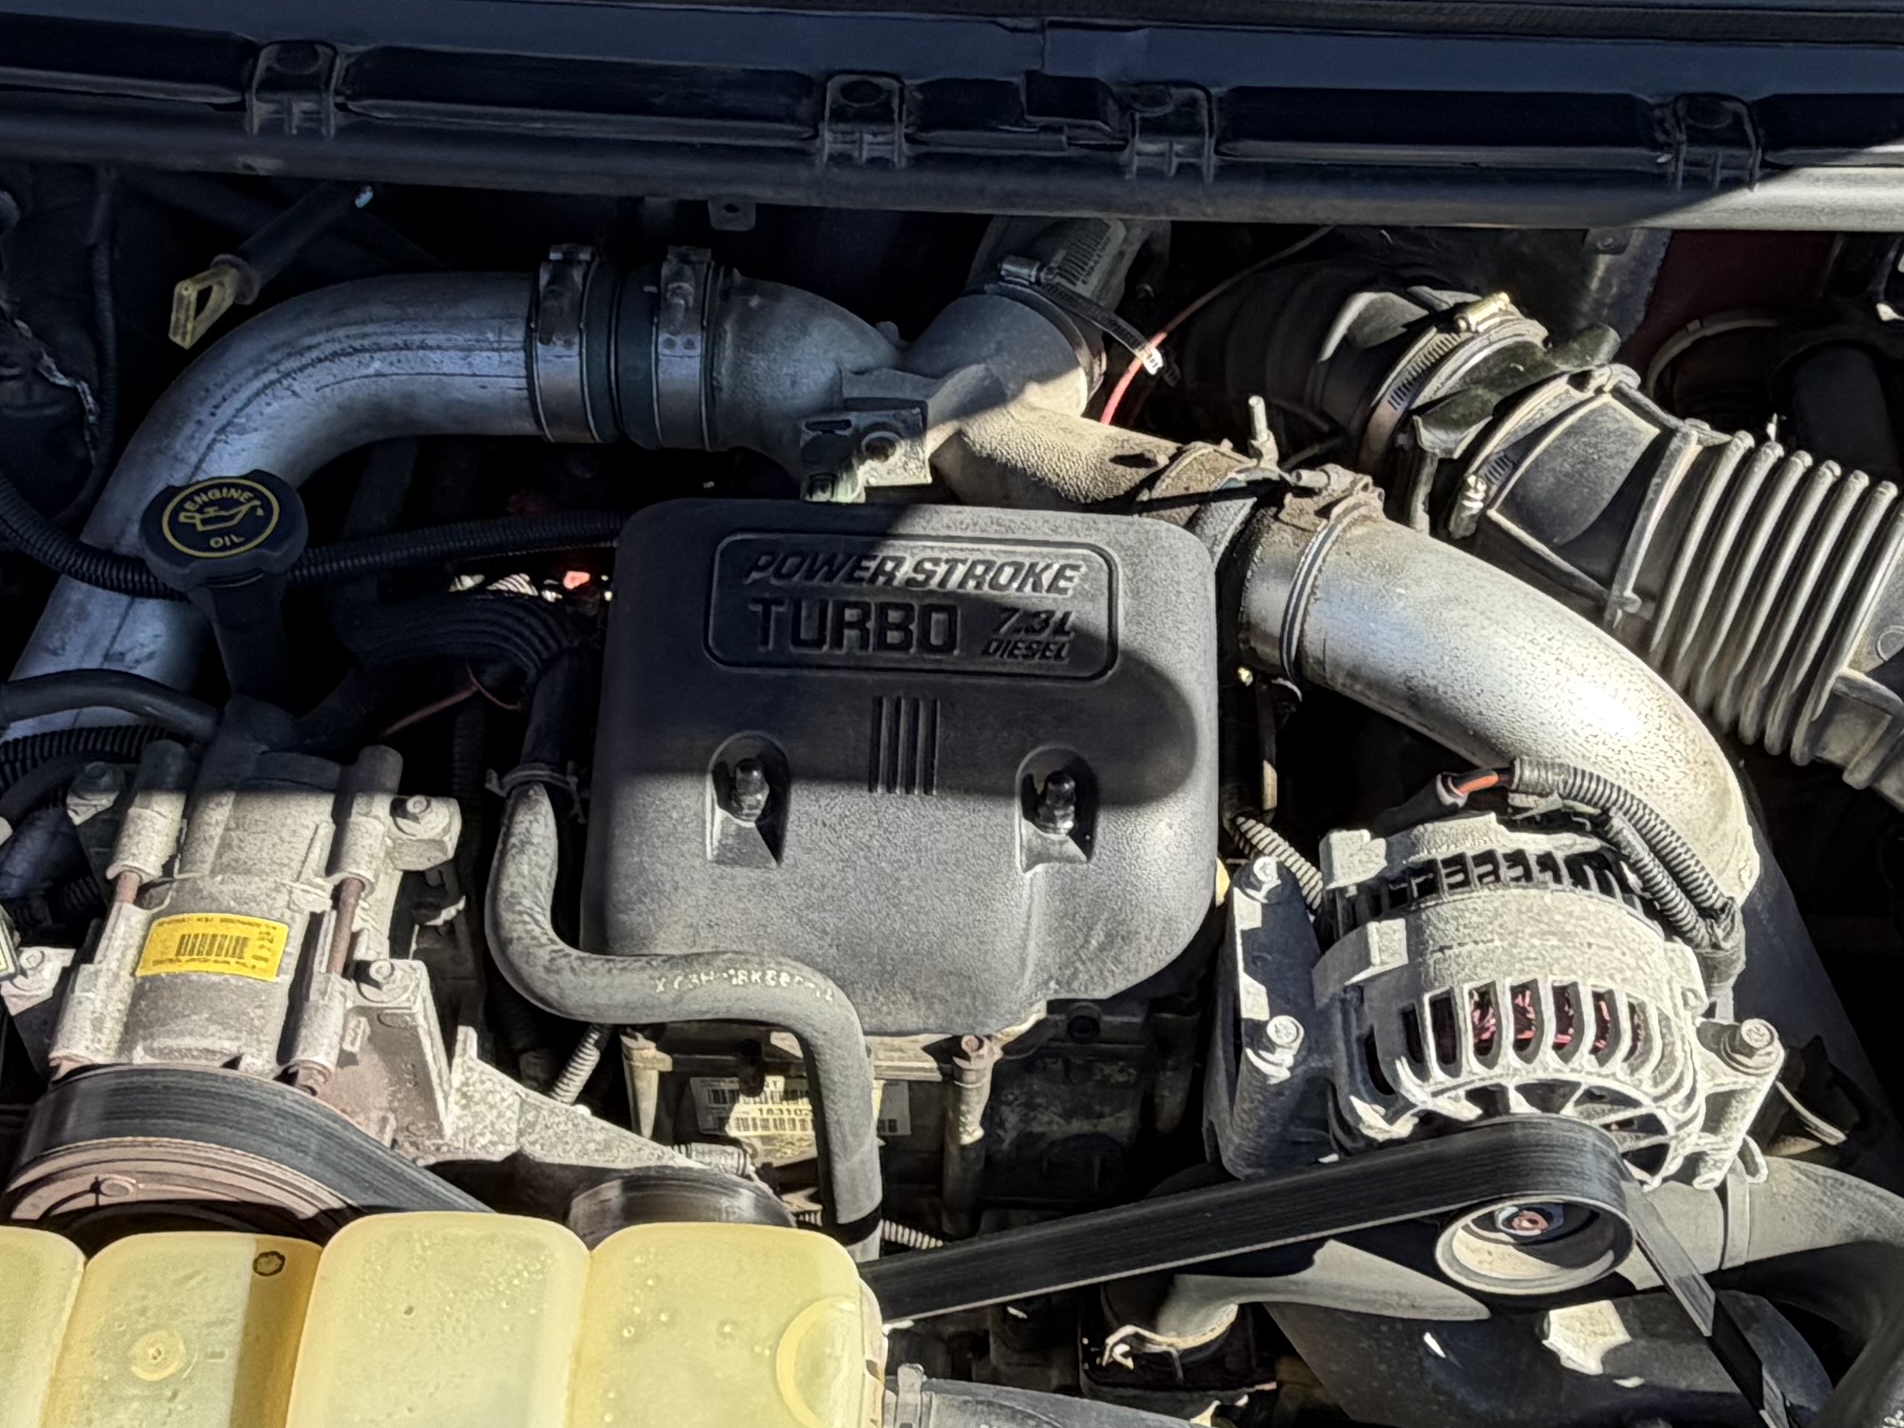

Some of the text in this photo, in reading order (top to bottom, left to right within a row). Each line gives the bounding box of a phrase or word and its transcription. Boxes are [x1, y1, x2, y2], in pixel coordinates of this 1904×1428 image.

[183, 486, 255, 512] ENGINE
[209, 534, 245, 548] OIL
[744, 548, 1088, 596] POWER STROKE
[749, 596, 961, 656] TURBO
[989, 606, 1074, 639] 7.3L
[981, 634, 1072, 662] DIESEL
